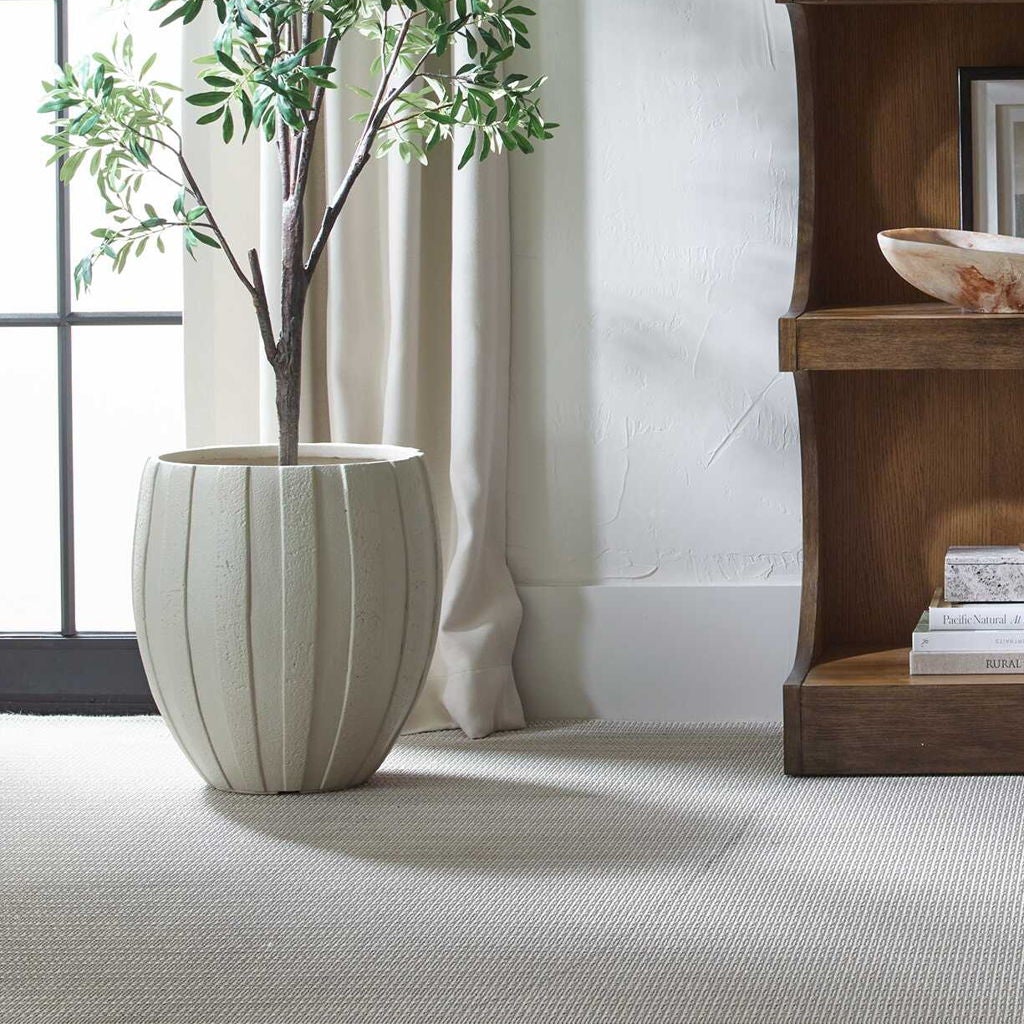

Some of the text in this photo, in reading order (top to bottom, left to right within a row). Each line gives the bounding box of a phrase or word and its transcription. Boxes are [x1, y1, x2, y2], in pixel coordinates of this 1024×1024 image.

[943, 615, 972, 625] Pacific
[973, 615, 1007, 625] Natural
[1010, 615, 1022, 625] At
[985, 659, 1021, 669] RURAL
